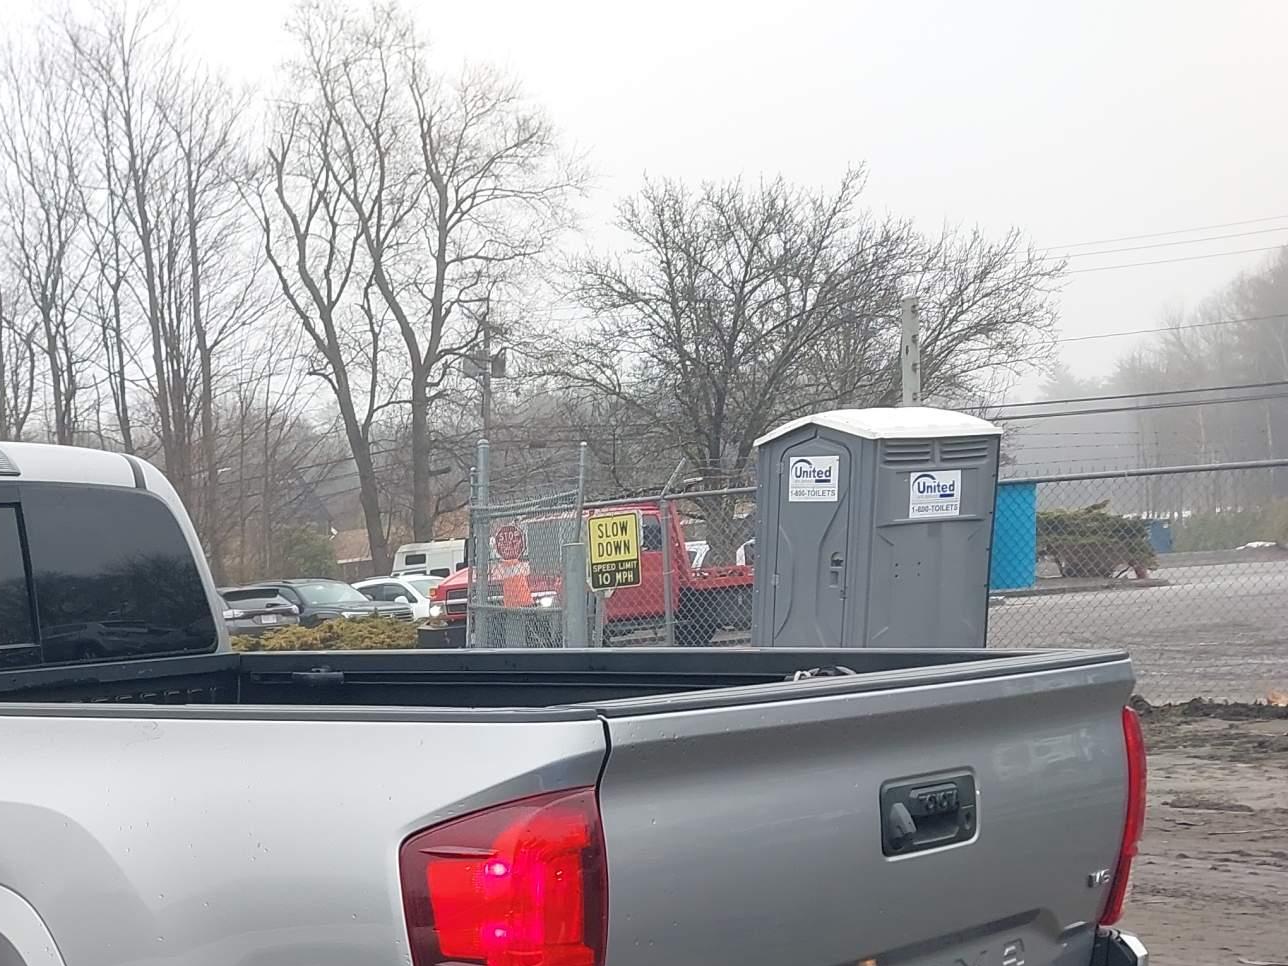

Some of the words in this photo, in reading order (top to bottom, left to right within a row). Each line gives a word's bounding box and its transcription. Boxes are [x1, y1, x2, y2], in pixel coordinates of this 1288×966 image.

[795, 466, 831, 478] United
[917, 480, 955, 494] United
[597, 520, 628, 539] SLOW
[598, 539, 630, 557] DOWN
[593, 563, 616, 572] SPEED
[619, 561, 638, 570] LIMIT
[598, 572, 611, 586] 10
[615, 570, 634, 584] MPH
